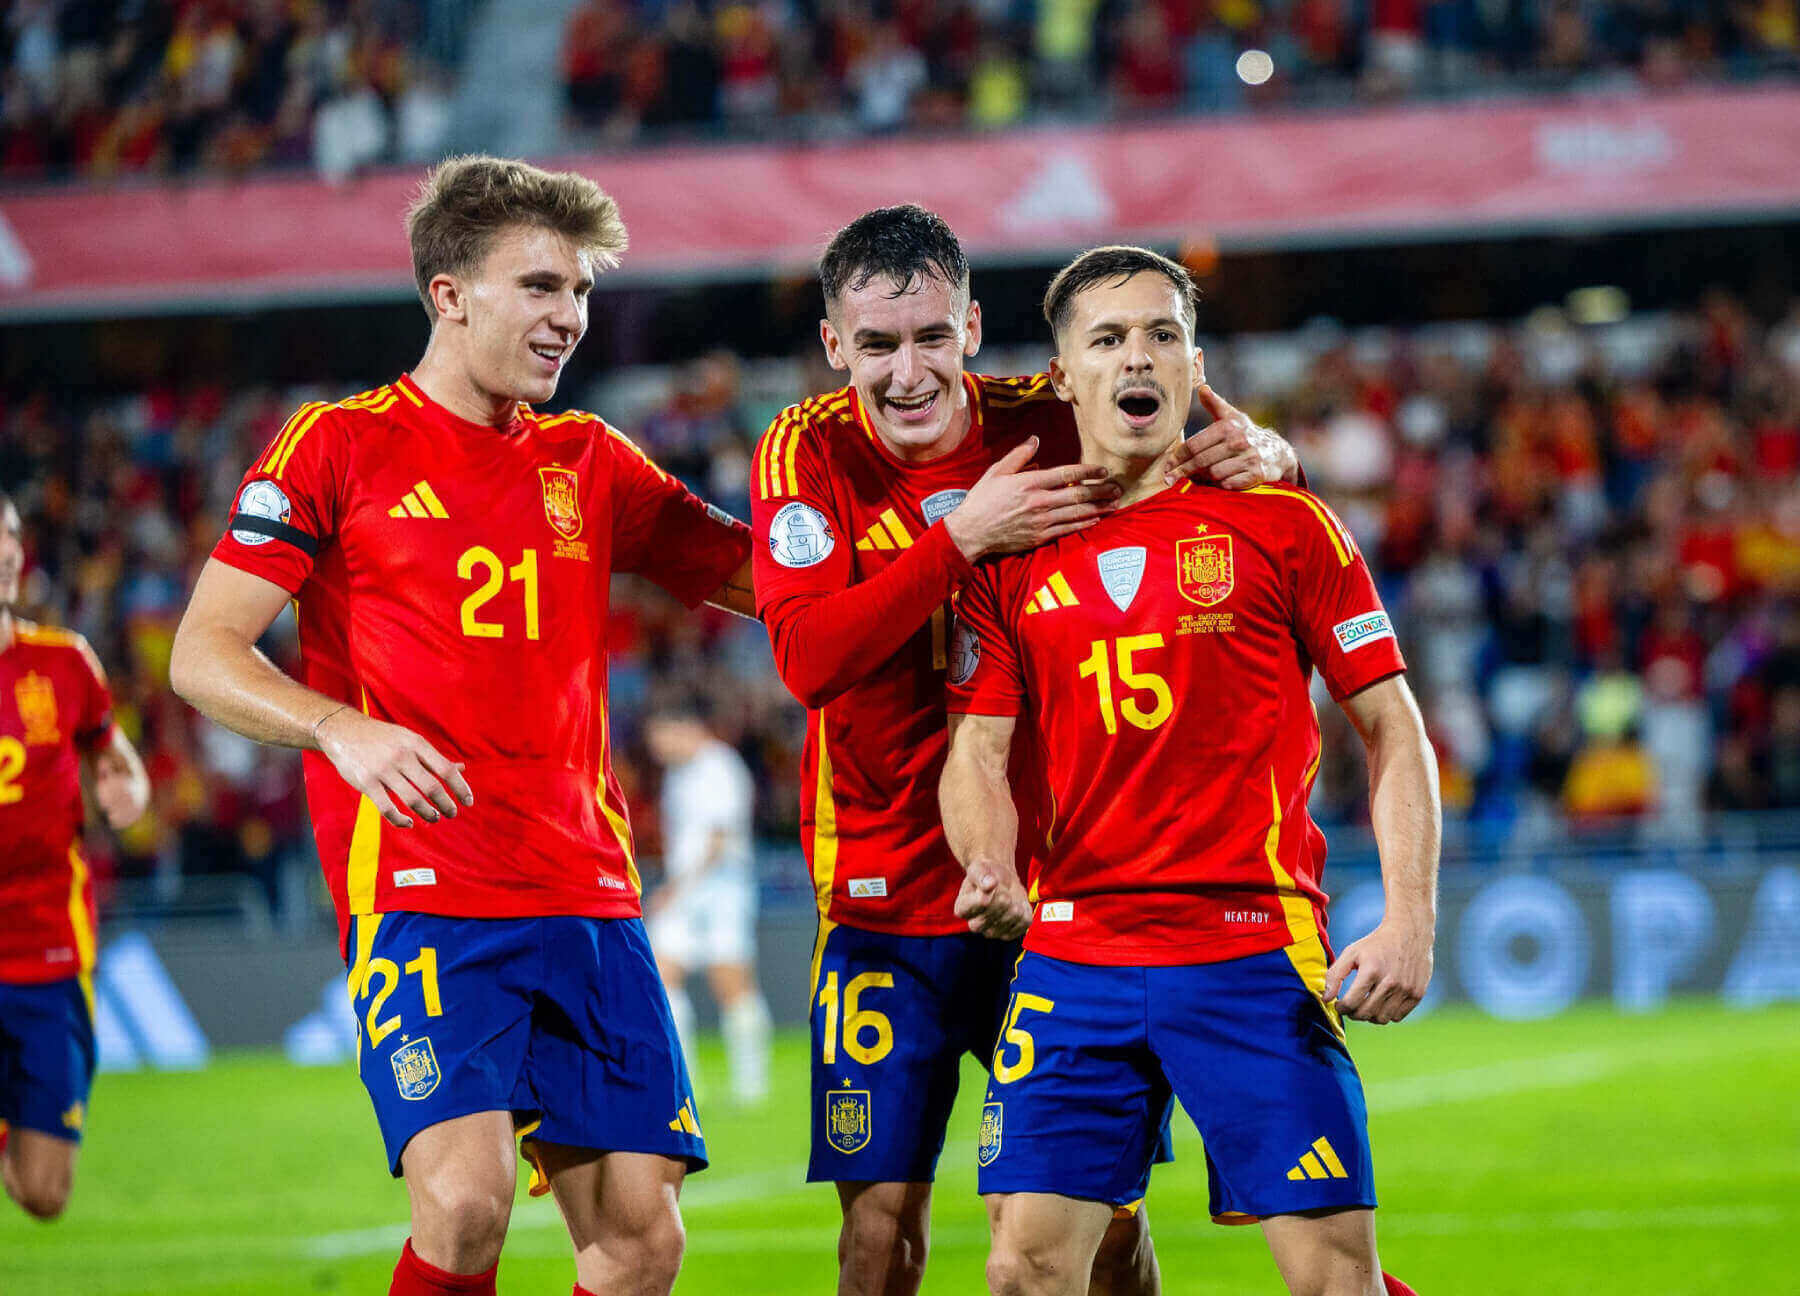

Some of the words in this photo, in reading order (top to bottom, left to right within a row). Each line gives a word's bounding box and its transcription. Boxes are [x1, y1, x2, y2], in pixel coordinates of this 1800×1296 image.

[457, 545, 540, 641] 21
[1336, 621, 1354, 633] UEFA
[1079, 632, 1174, 736] 15
[1224, 911, 1269, 925] HEAT.RDY
[360, 947, 443, 1050] 21
[819, 970, 895, 1065] 16
[993, 992, 1054, 1084] 5
